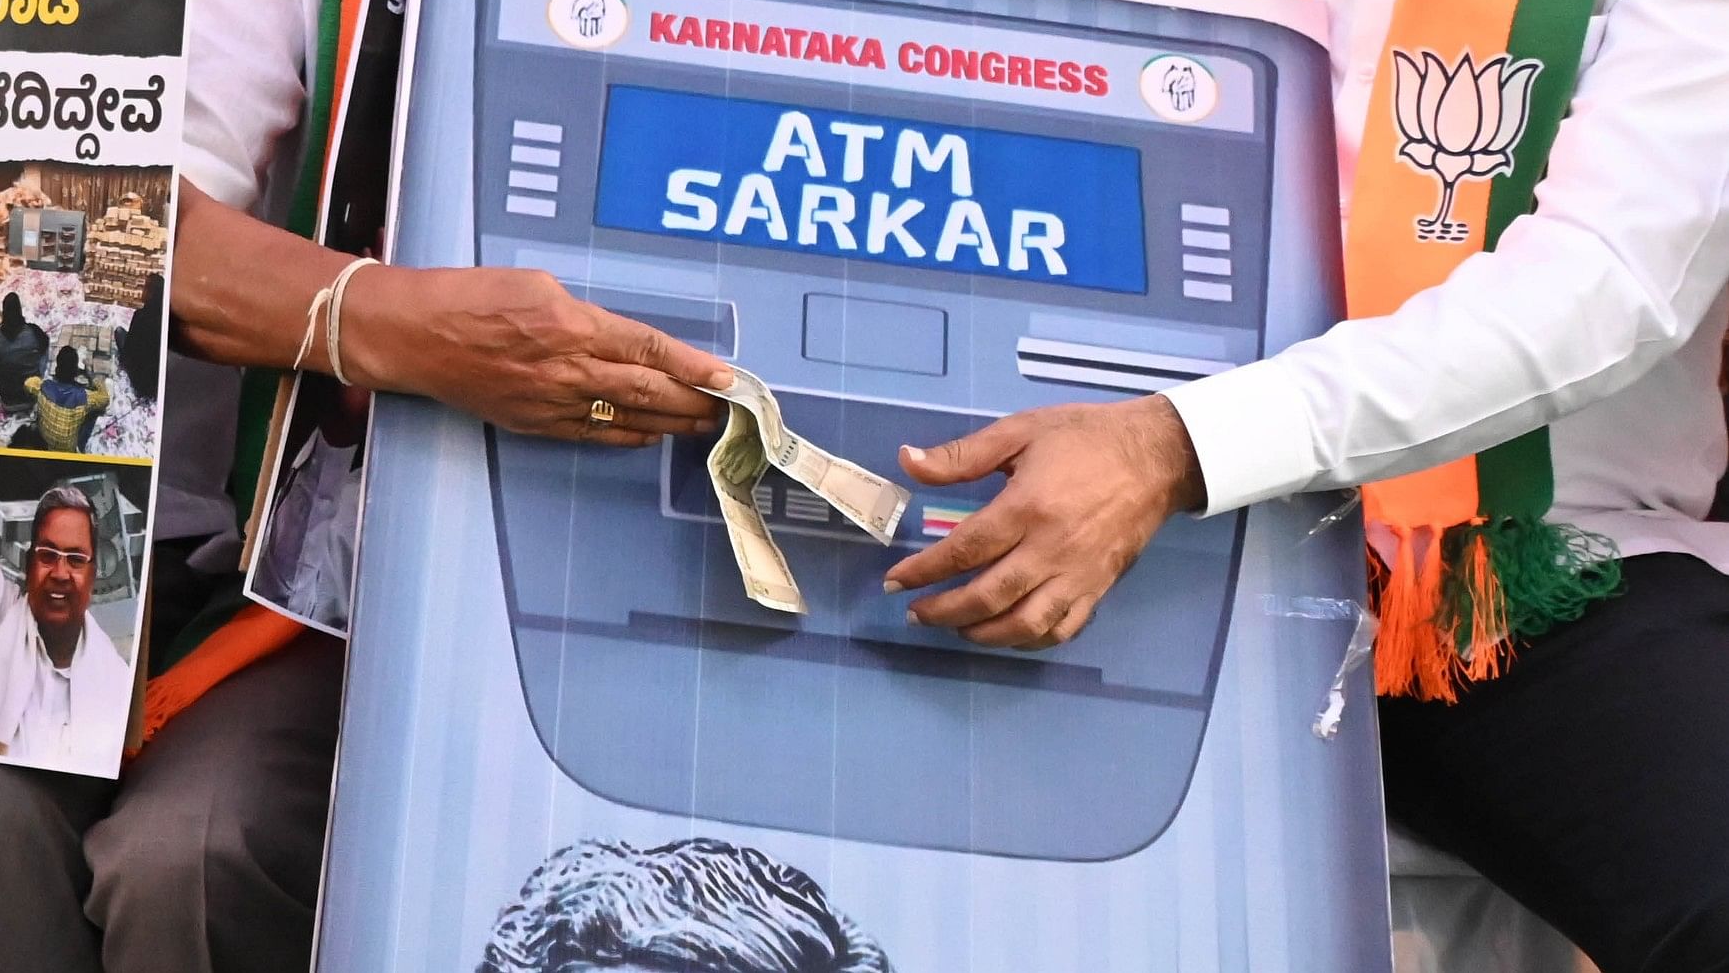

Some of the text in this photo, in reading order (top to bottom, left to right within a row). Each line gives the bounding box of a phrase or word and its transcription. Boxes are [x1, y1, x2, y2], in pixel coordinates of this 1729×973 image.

[649, 11, 1110, 98] KARNATAKA CONGRESS
[763, 110, 974, 197] ATM
[662, 169, 1069, 277] SARKAR
